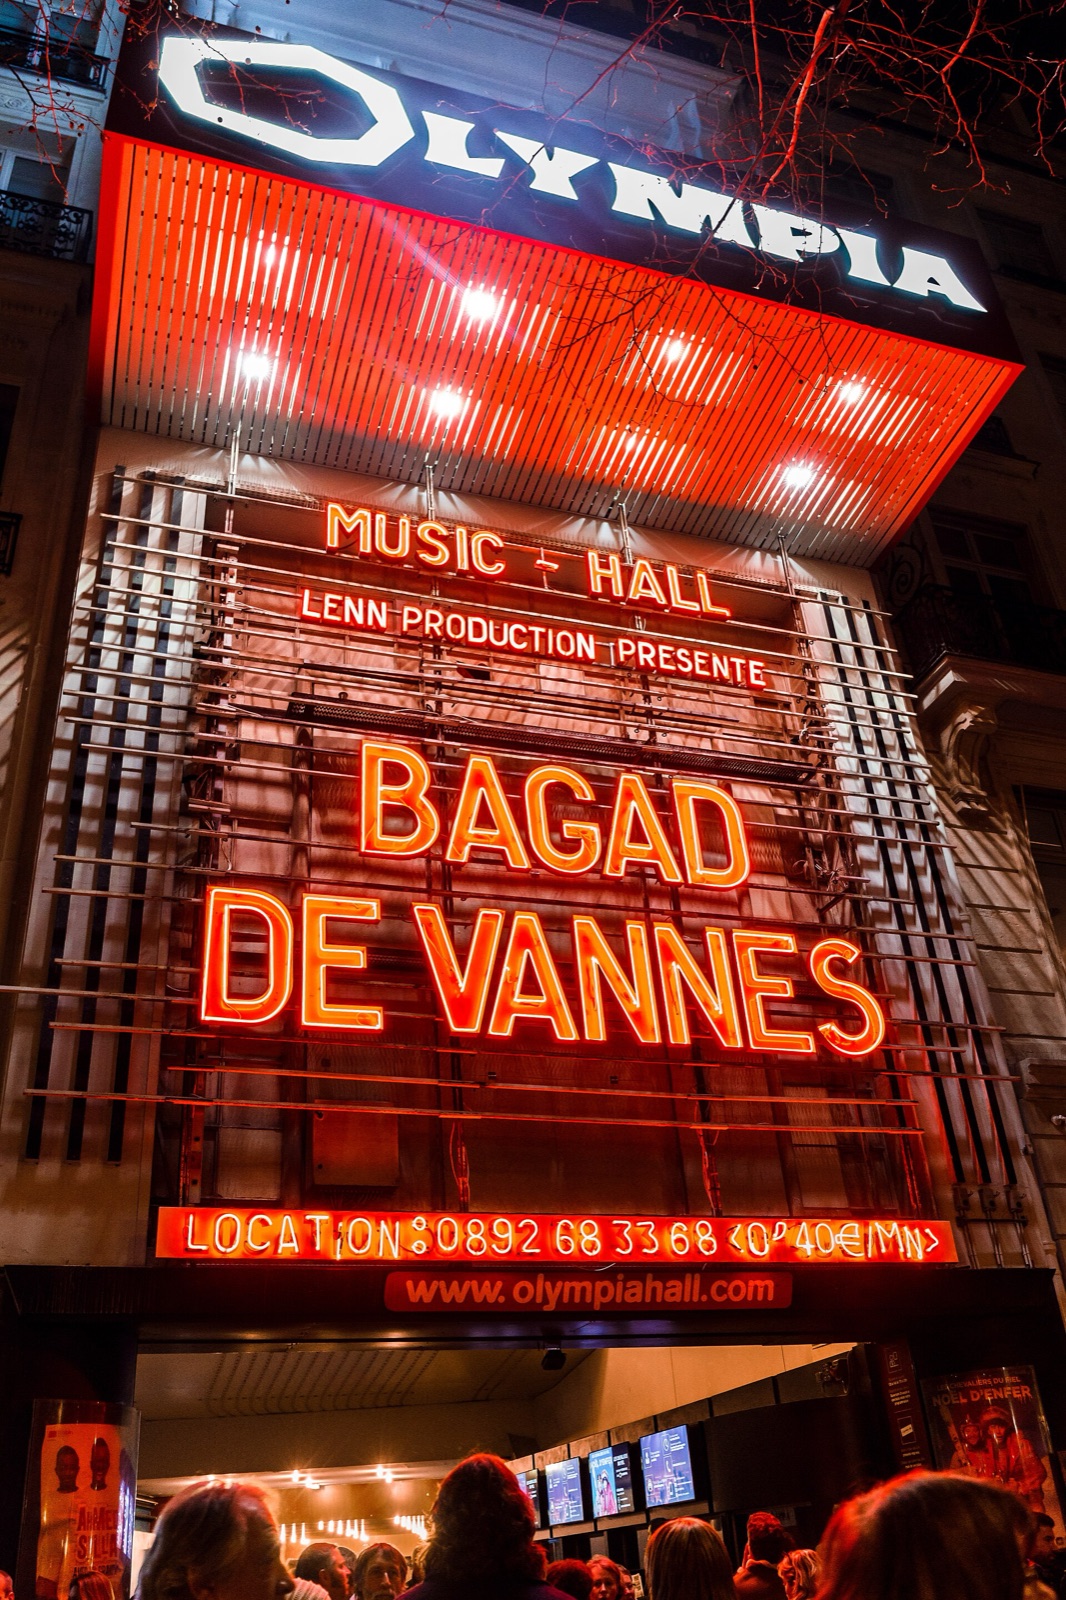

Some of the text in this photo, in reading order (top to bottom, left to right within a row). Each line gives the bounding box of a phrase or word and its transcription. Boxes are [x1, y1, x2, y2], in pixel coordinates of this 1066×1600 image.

[157, 36, 988, 313] OLYMPIA
[325, 500, 507, 578] MUSIC
[585, 548, 733, 622] HALL
[300, 588, 768, 690] LENN PRODUCTION PRESENTE
[359, 740, 752, 892] BAGAD
[199, 885, 887, 1058] DE VANNES
[406, 1273, 774, 1311] www.olympiahall.com
[555, 1218, 601, 1256] 68
[612, 1219, 661, 1255] 33
[669, 1219, 717, 1257] 68
[969, 1385, 1032, 1402] D'ENFER
